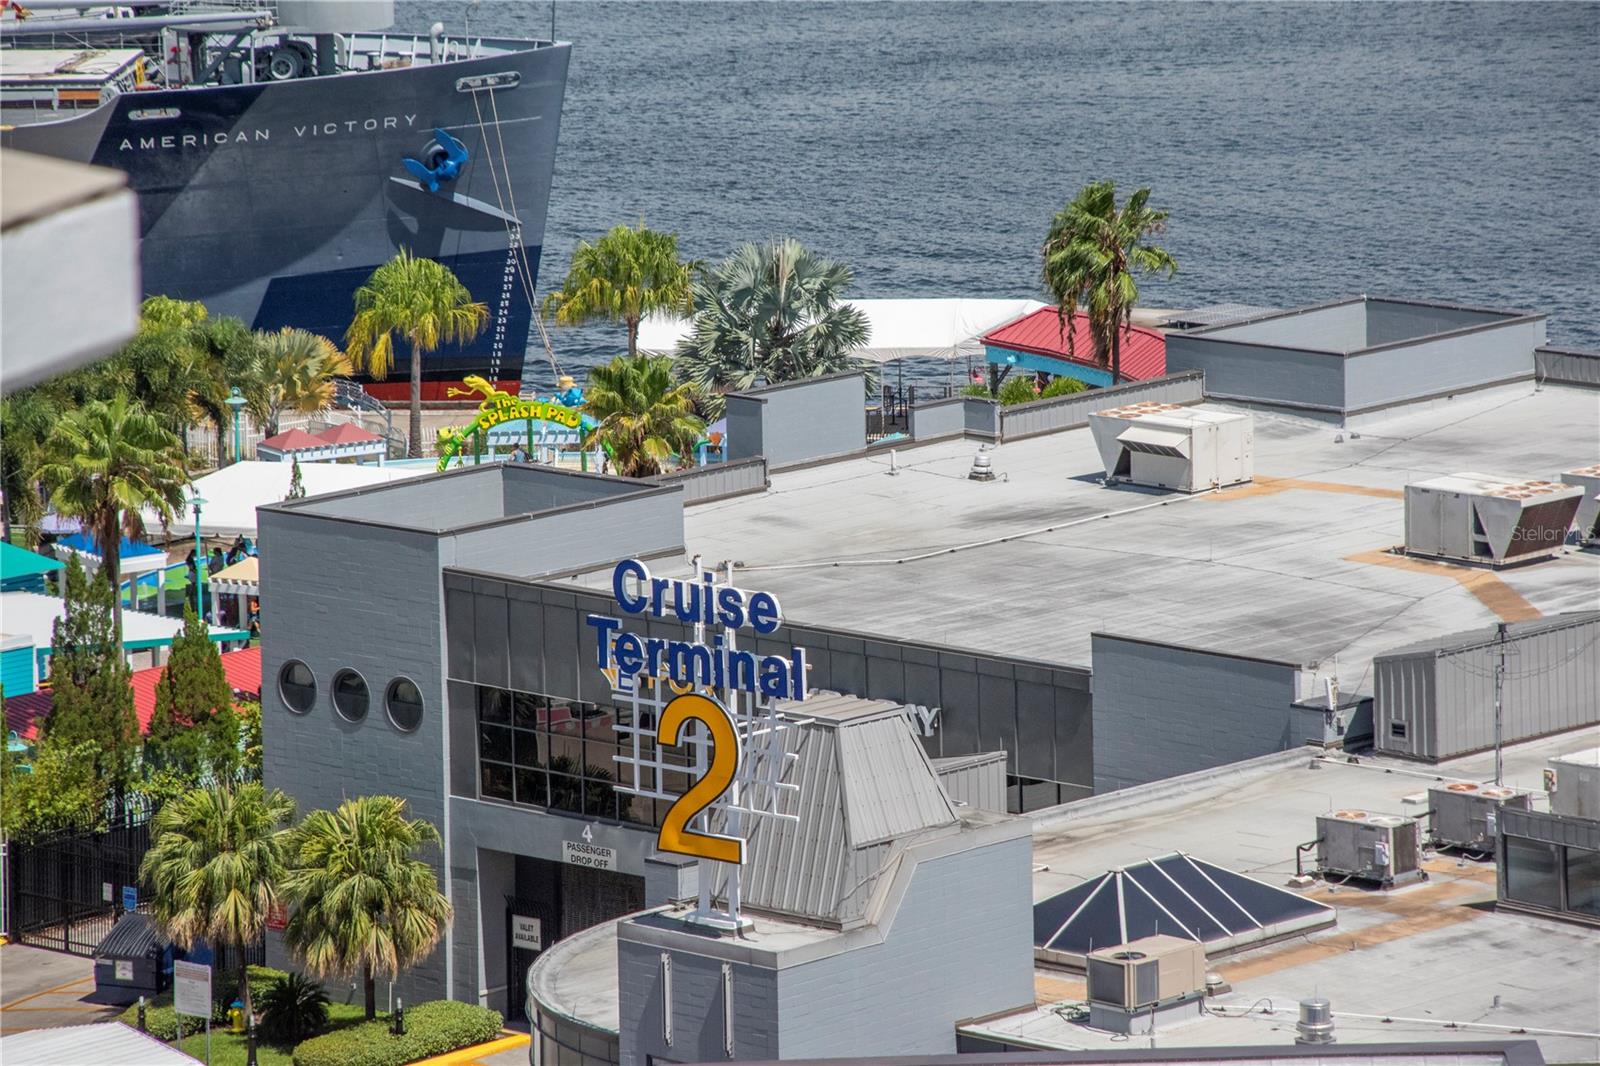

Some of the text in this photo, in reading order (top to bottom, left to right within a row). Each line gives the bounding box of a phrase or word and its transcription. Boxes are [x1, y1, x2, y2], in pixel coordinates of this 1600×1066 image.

[119, 113, 417, 151] AMERICAN VICTORY
[479, 405, 578, 429] SPLASH PAD
[612, 559, 784, 634] Cruise
[586, 614, 806, 700] Terminal
[656, 693, 747, 864] 2
[581, 824, 593, 843] 4
[566, 842, 612, 858] PASSENGER
[570, 854, 609, 868] DROP OFF
